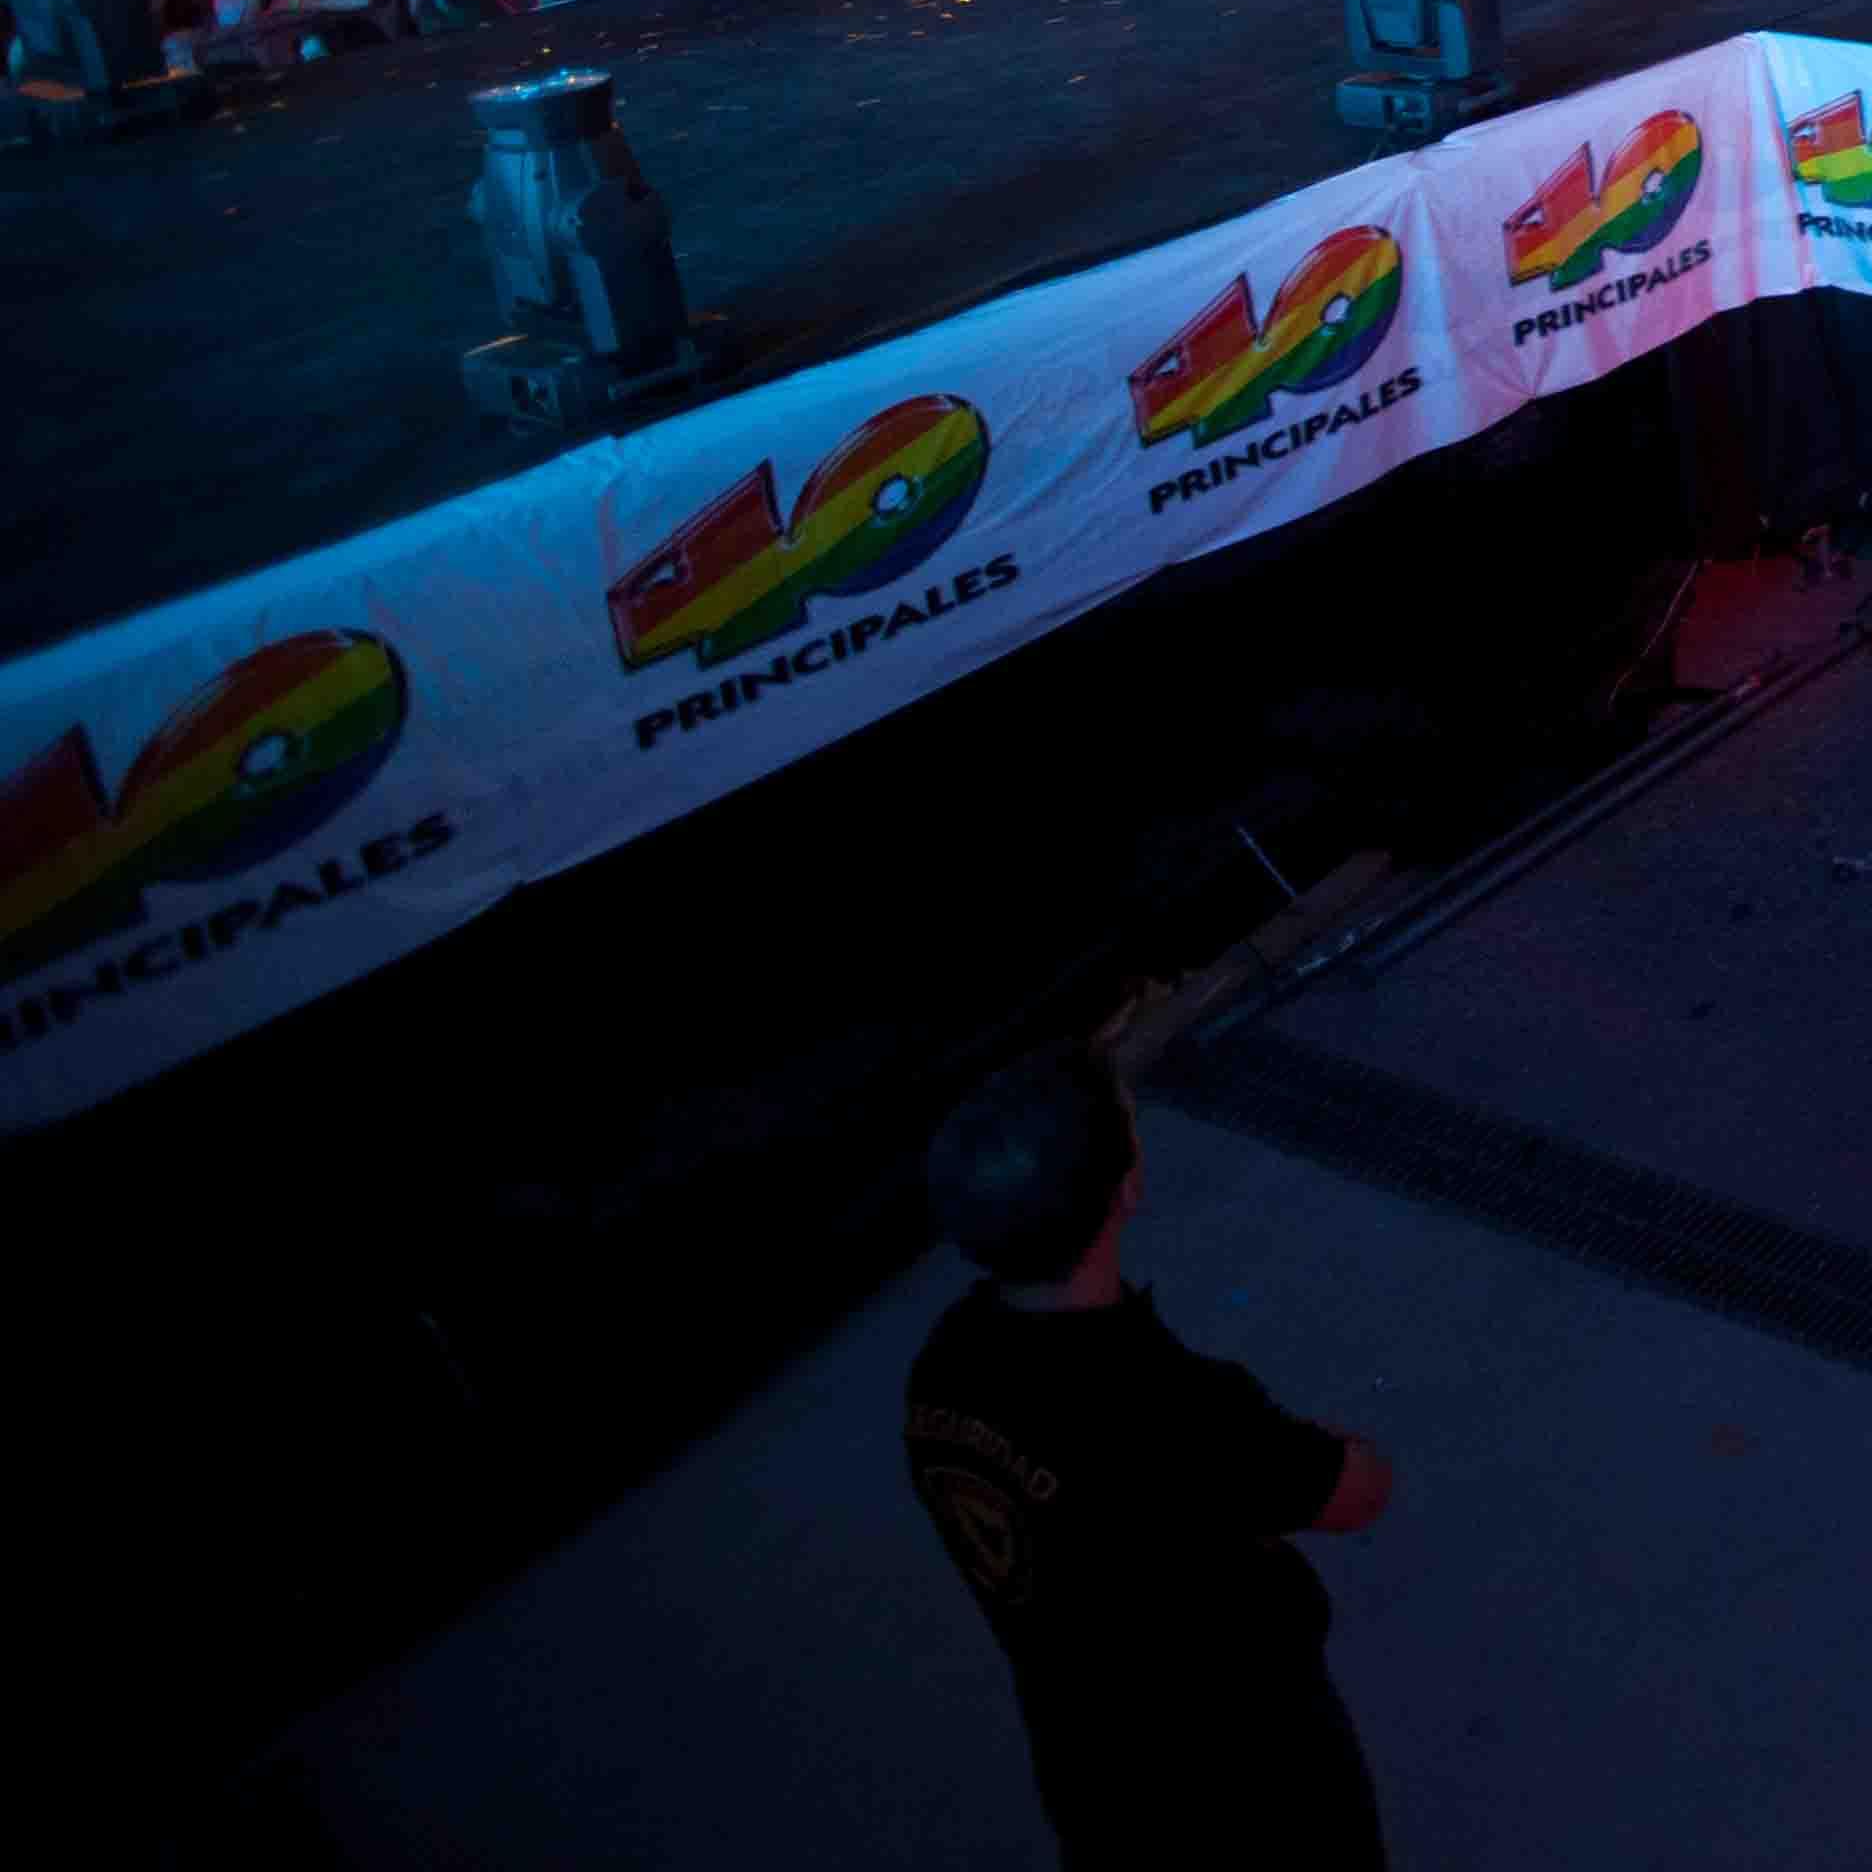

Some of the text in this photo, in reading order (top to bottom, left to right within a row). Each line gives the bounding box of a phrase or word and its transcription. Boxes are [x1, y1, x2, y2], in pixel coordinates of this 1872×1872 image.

[1513, 239, 1714, 347] PRINCIPALES
[1149, 366, 1422, 514] PRINCIPALES
[634, 551, 1021, 753] PRINCIPALES
